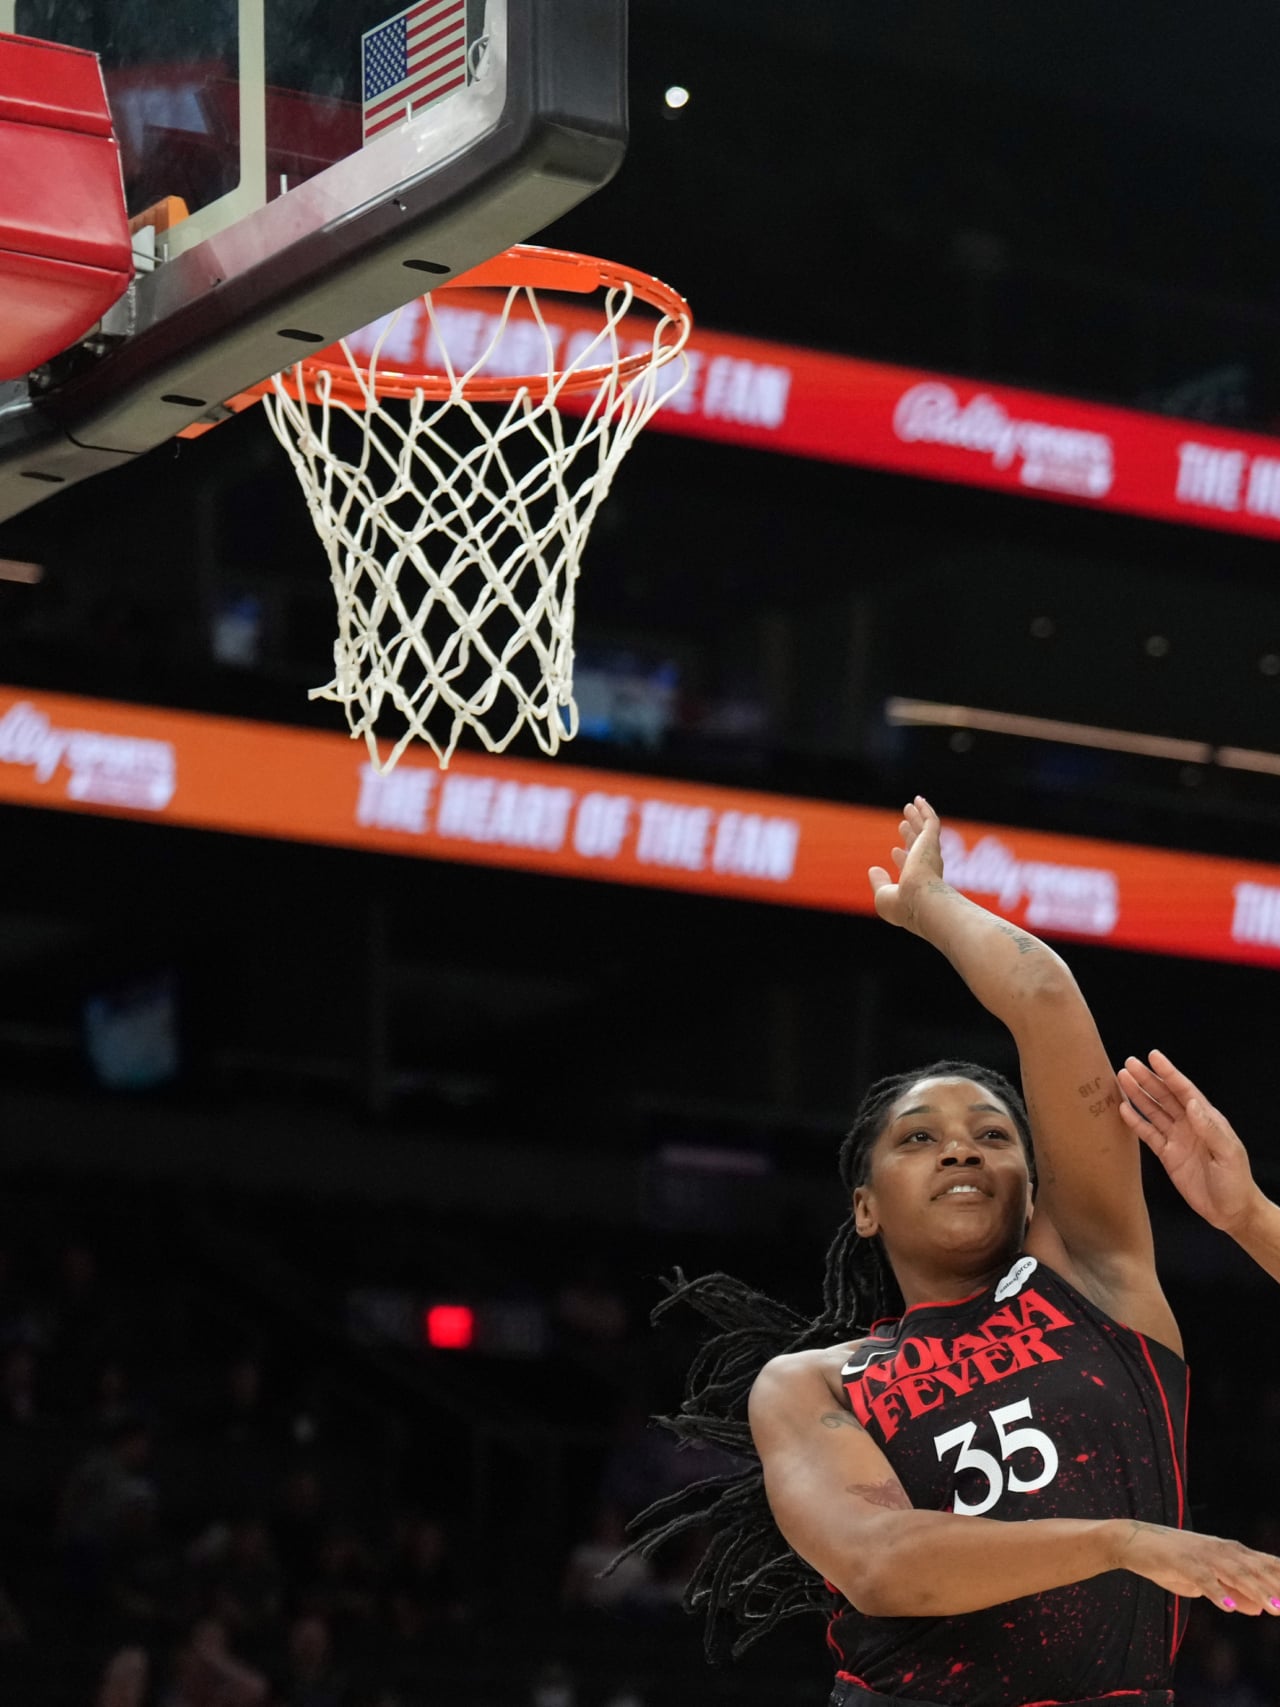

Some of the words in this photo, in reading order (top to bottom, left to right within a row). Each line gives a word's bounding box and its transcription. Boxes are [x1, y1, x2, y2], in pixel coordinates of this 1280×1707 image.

[1176, 441, 1246, 511] THE
[0, 700, 62, 785] lly
[357, 762, 437, 834] THE
[436, 773, 574, 853] HEART
[572, 791, 634, 859] OF
[635, 800, 712, 871] THE
[712, 809, 799, 882] FAN
[843, 1288, 1075, 1429] INDIANA
[868, 1326, 1063, 1443] FEVER
[934, 1397, 1059, 1517] 35
